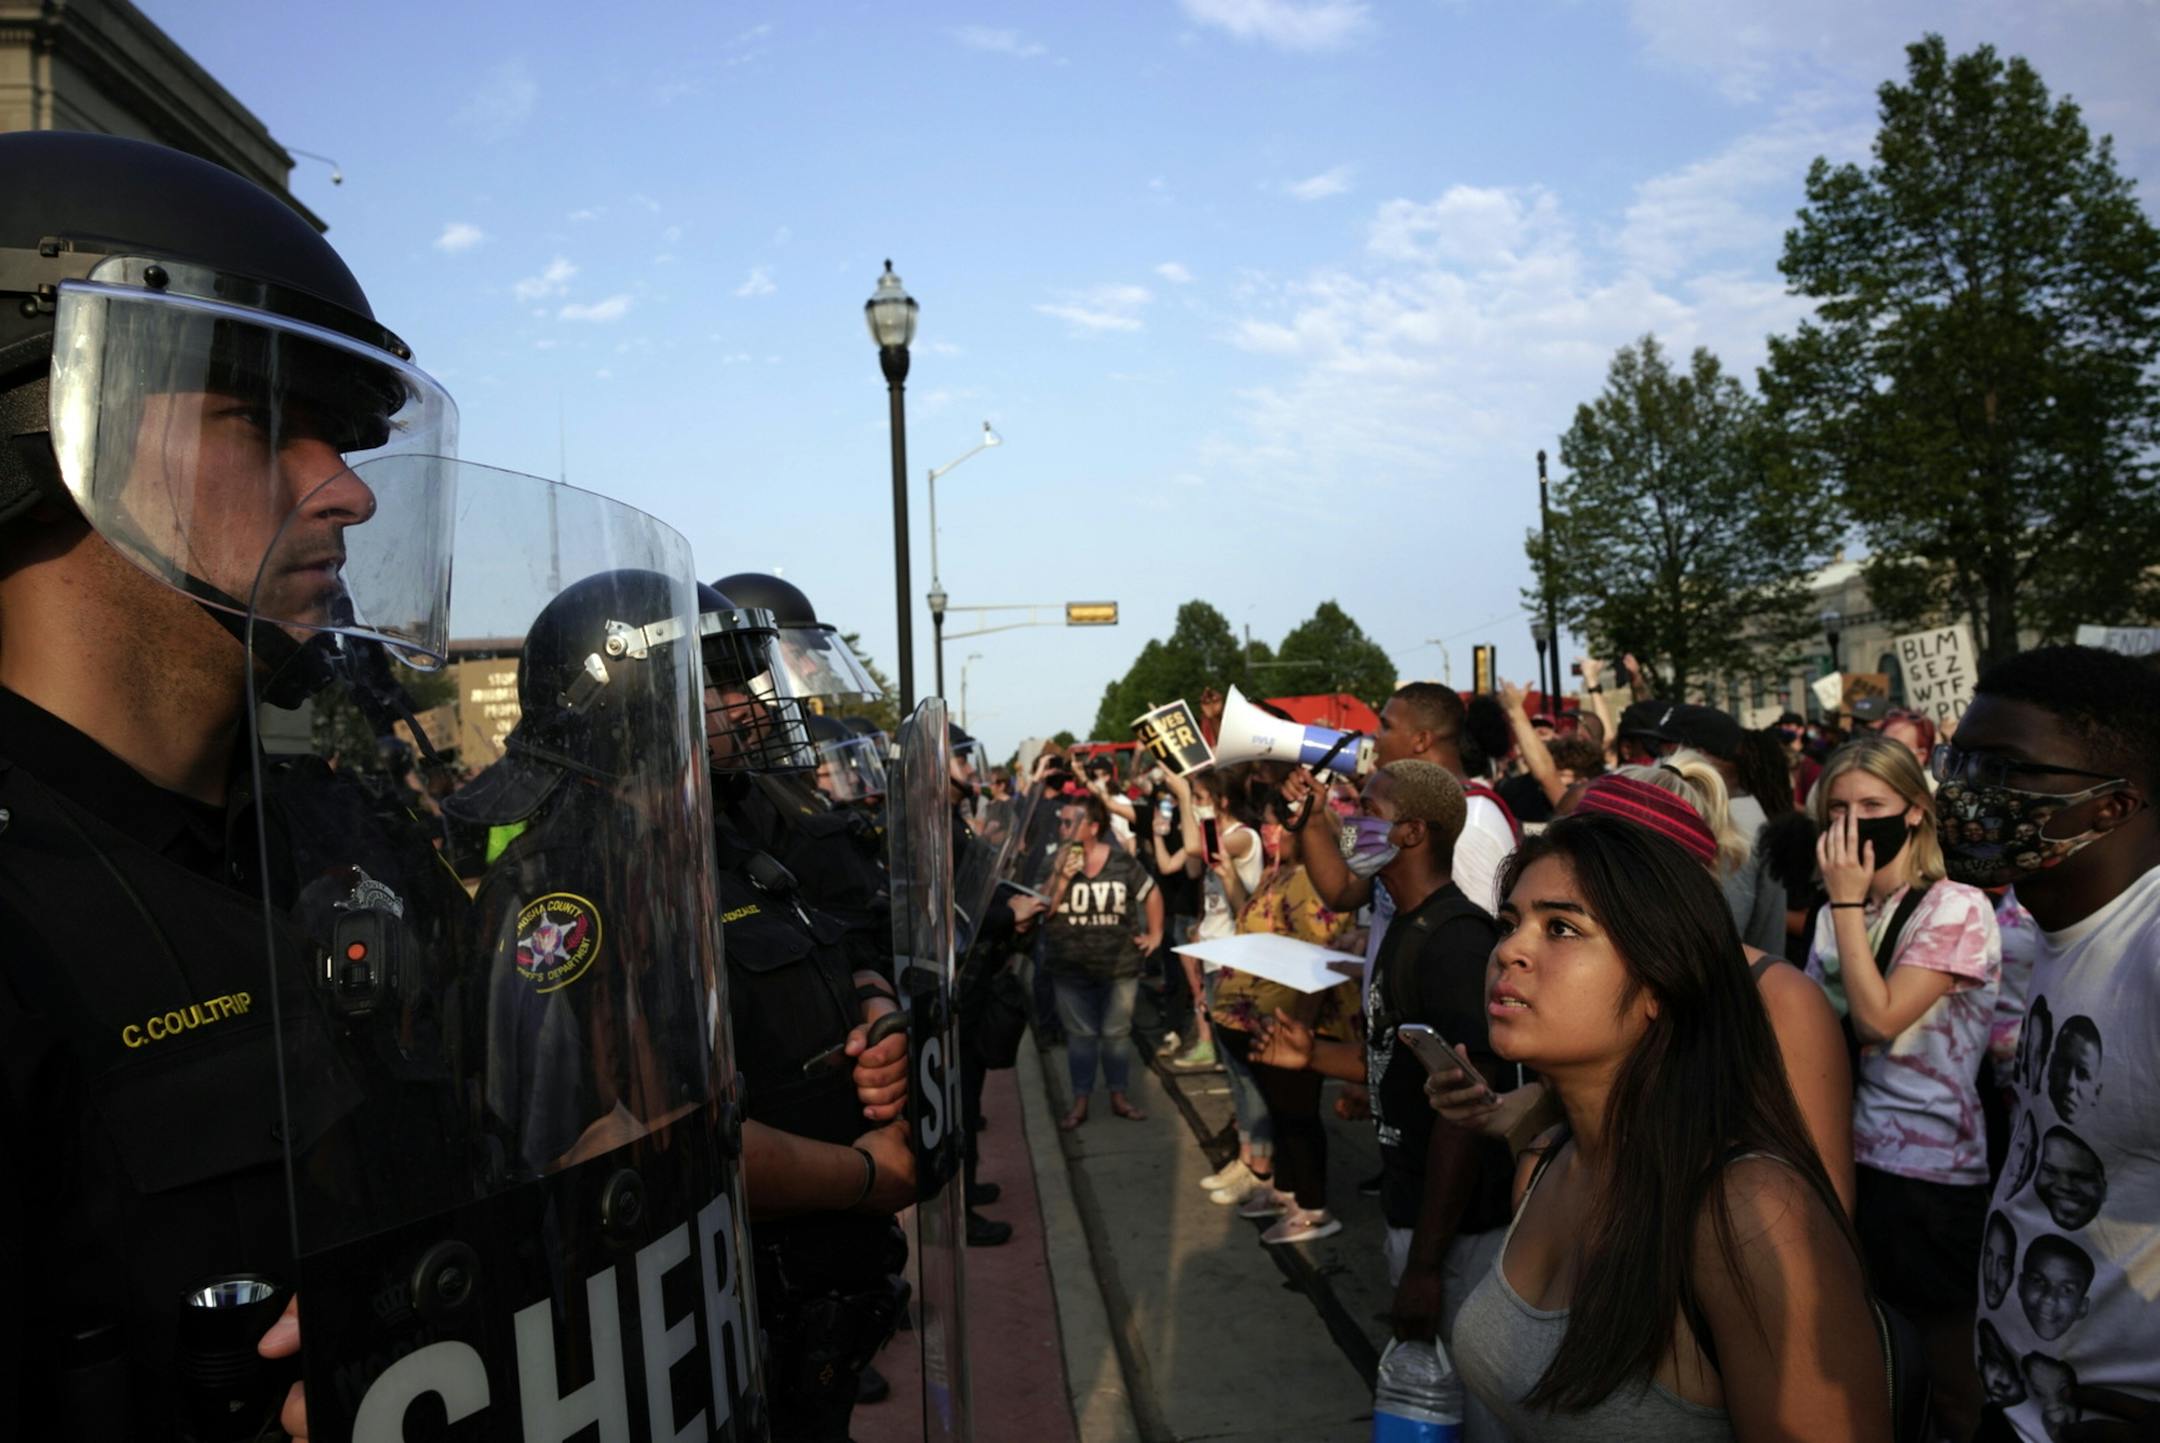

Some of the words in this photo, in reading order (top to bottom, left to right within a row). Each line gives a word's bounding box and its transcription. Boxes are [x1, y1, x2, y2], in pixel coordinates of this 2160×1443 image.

[1902, 630, 1959, 663] BLM
[1913, 677, 1965, 701] WTF
[1919, 699, 1969, 721] PD
[547, 900, 583, 918] COUNTY
[1057, 881, 1127, 914] OVE
[547, 937, 592, 980] DEPARTMENT
